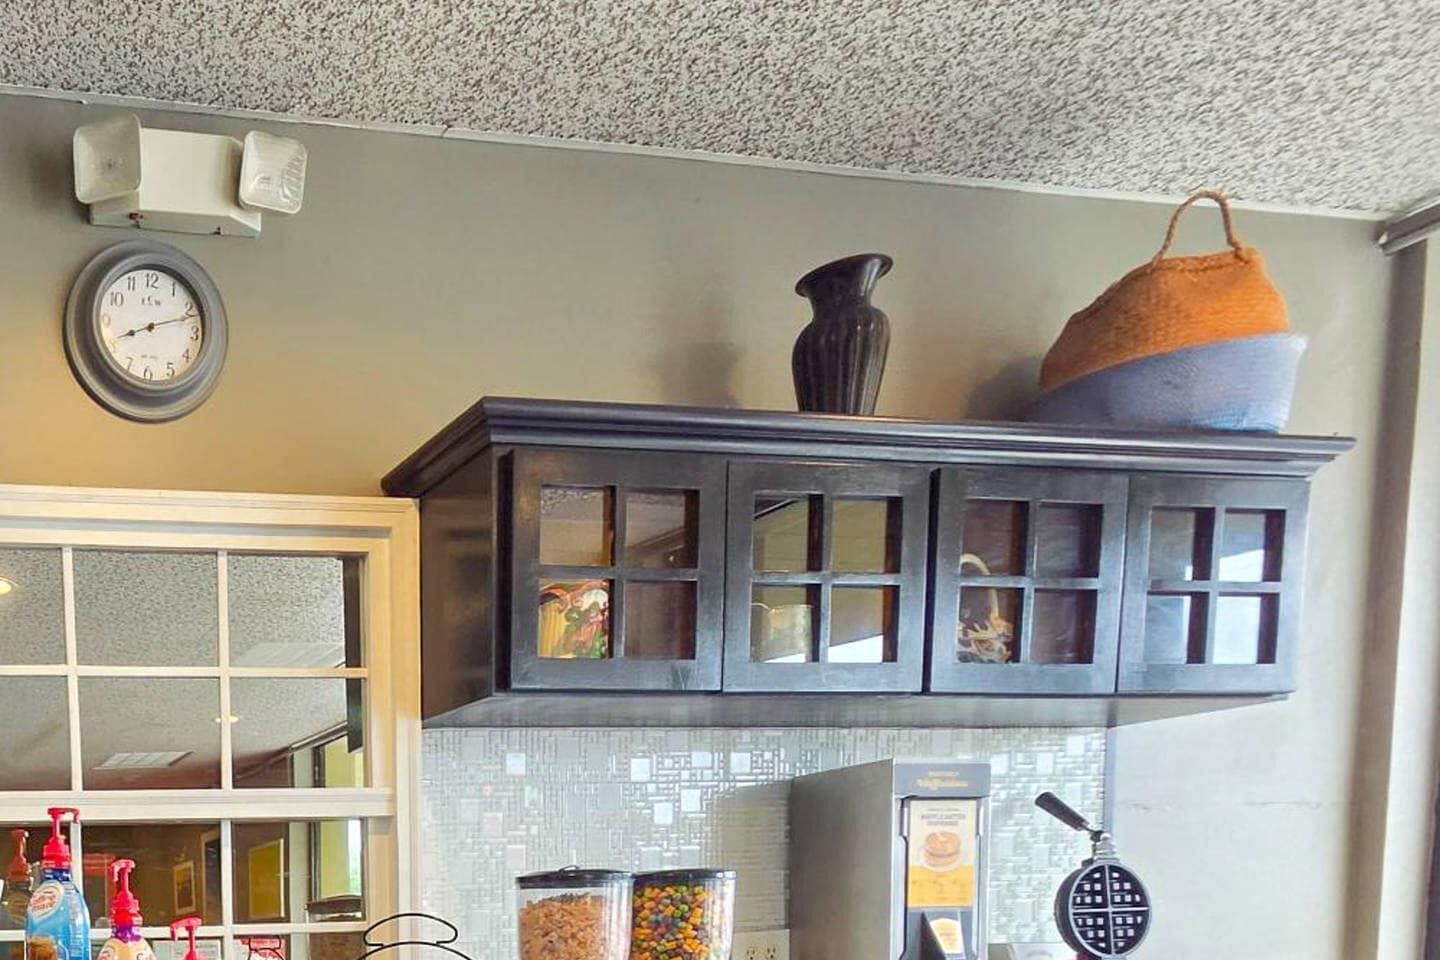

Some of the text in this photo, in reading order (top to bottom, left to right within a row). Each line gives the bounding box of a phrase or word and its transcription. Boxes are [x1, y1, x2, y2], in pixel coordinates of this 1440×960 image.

[127, 276, 136, 291] 11
[145, 272, 159, 289] 12
[110, 291, 124, 306] 10
[185, 301, 196, 317] 2
[190, 325, 199, 341] 3
[182, 348, 192, 362] 4
[126, 356, 134, 372] 7
[166, 362, 175, 377] 5
[143, 365, 153, 380] 6
